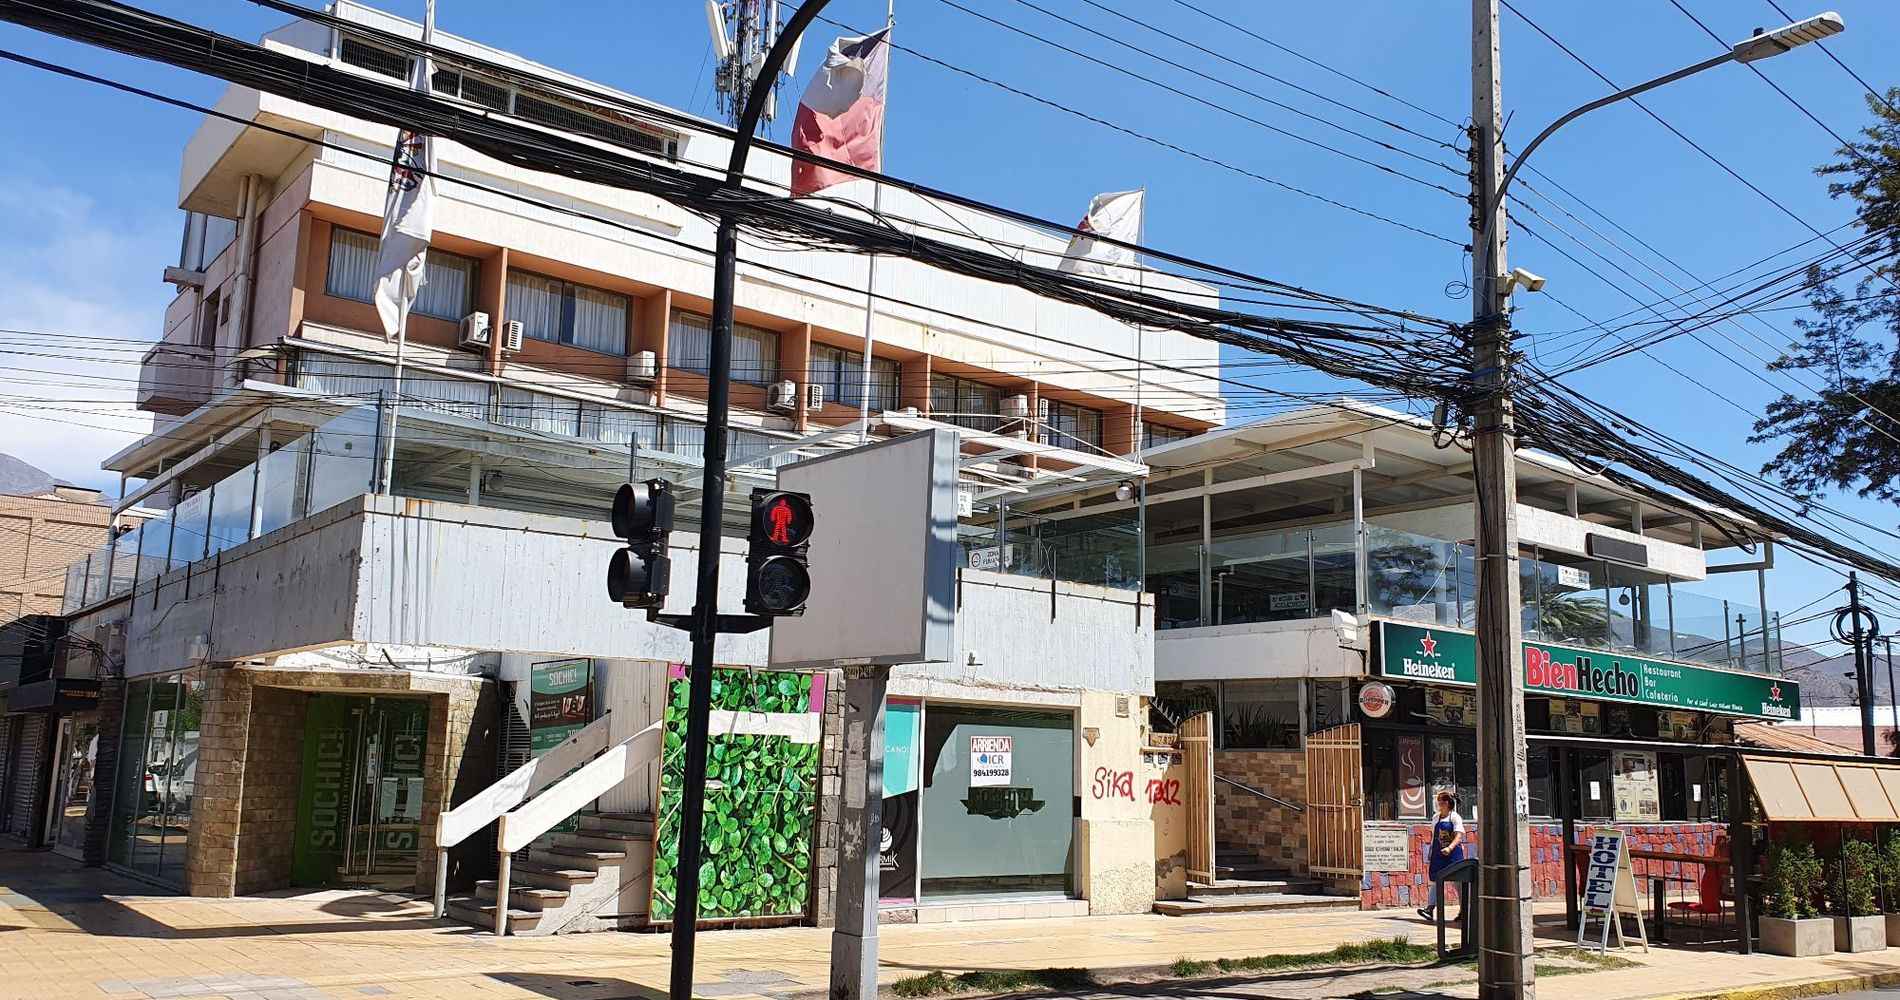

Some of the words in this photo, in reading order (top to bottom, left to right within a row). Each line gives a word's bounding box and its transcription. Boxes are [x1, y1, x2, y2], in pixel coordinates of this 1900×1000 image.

[1403, 658, 1455, 679] Heineken
[1525, 646, 1639, 698] BienHecho
[1643, 663, 1682, 679] Restaurant
[549, 668, 577, 687] SOCHIC!
[1644, 678, 1657, 688] Bar
[1761, 702, 1791, 717] Heineken
[972, 738, 1010, 751] ARRIENDA
[989, 754, 1004, 764] ICR
[1585, 836, 1618, 908] HOTEL
